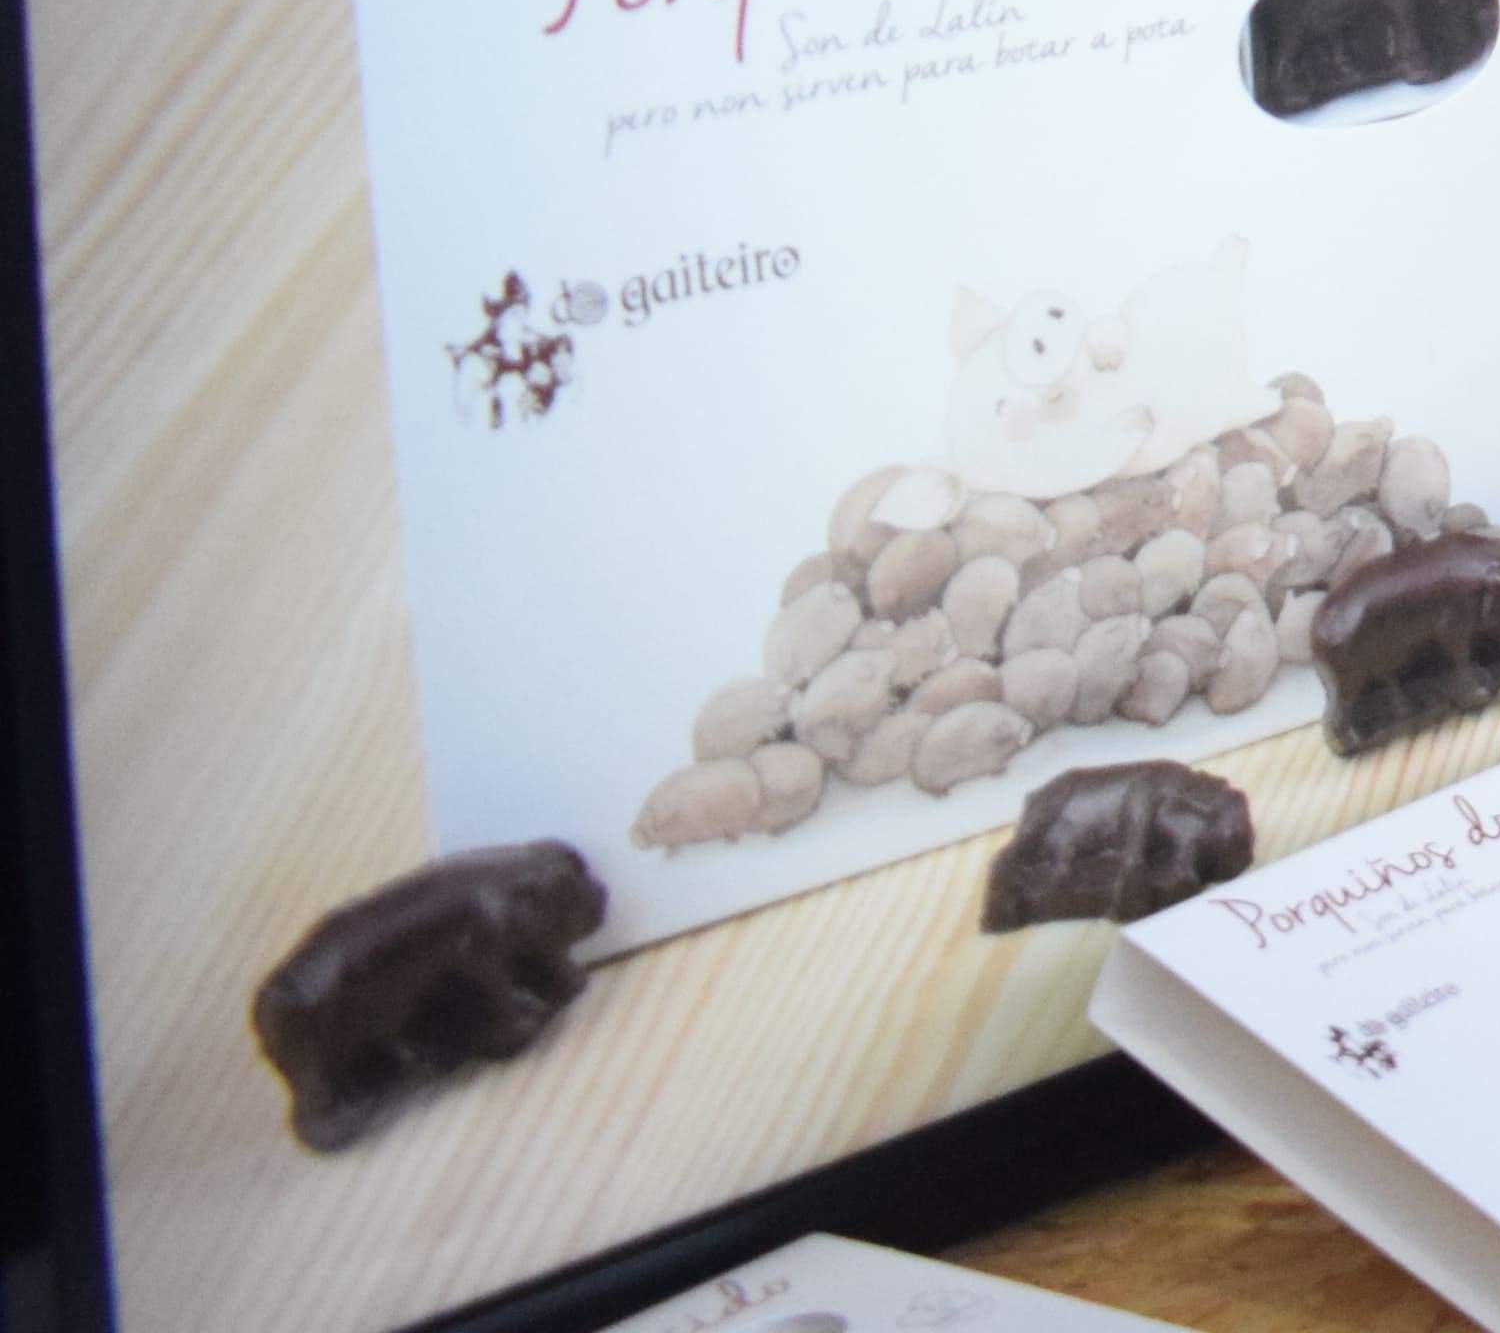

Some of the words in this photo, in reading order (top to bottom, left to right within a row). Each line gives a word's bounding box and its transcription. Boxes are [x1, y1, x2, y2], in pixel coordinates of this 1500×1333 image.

[604, 103, 677, 157] pero
[692, 92, 767, 122] non
[781, 68, 888, 113] sirven
[901, 55, 983, 103] para
[996, 30, 1077, 68] botar
[1091, 33, 1114, 51] a
[1123, 13, 1200, 62] pota
[779, 9, 846, 72] Son
[620, 241, 801, 328] gaiteiro
[1208, 841, 1457, 950] Porquiños
